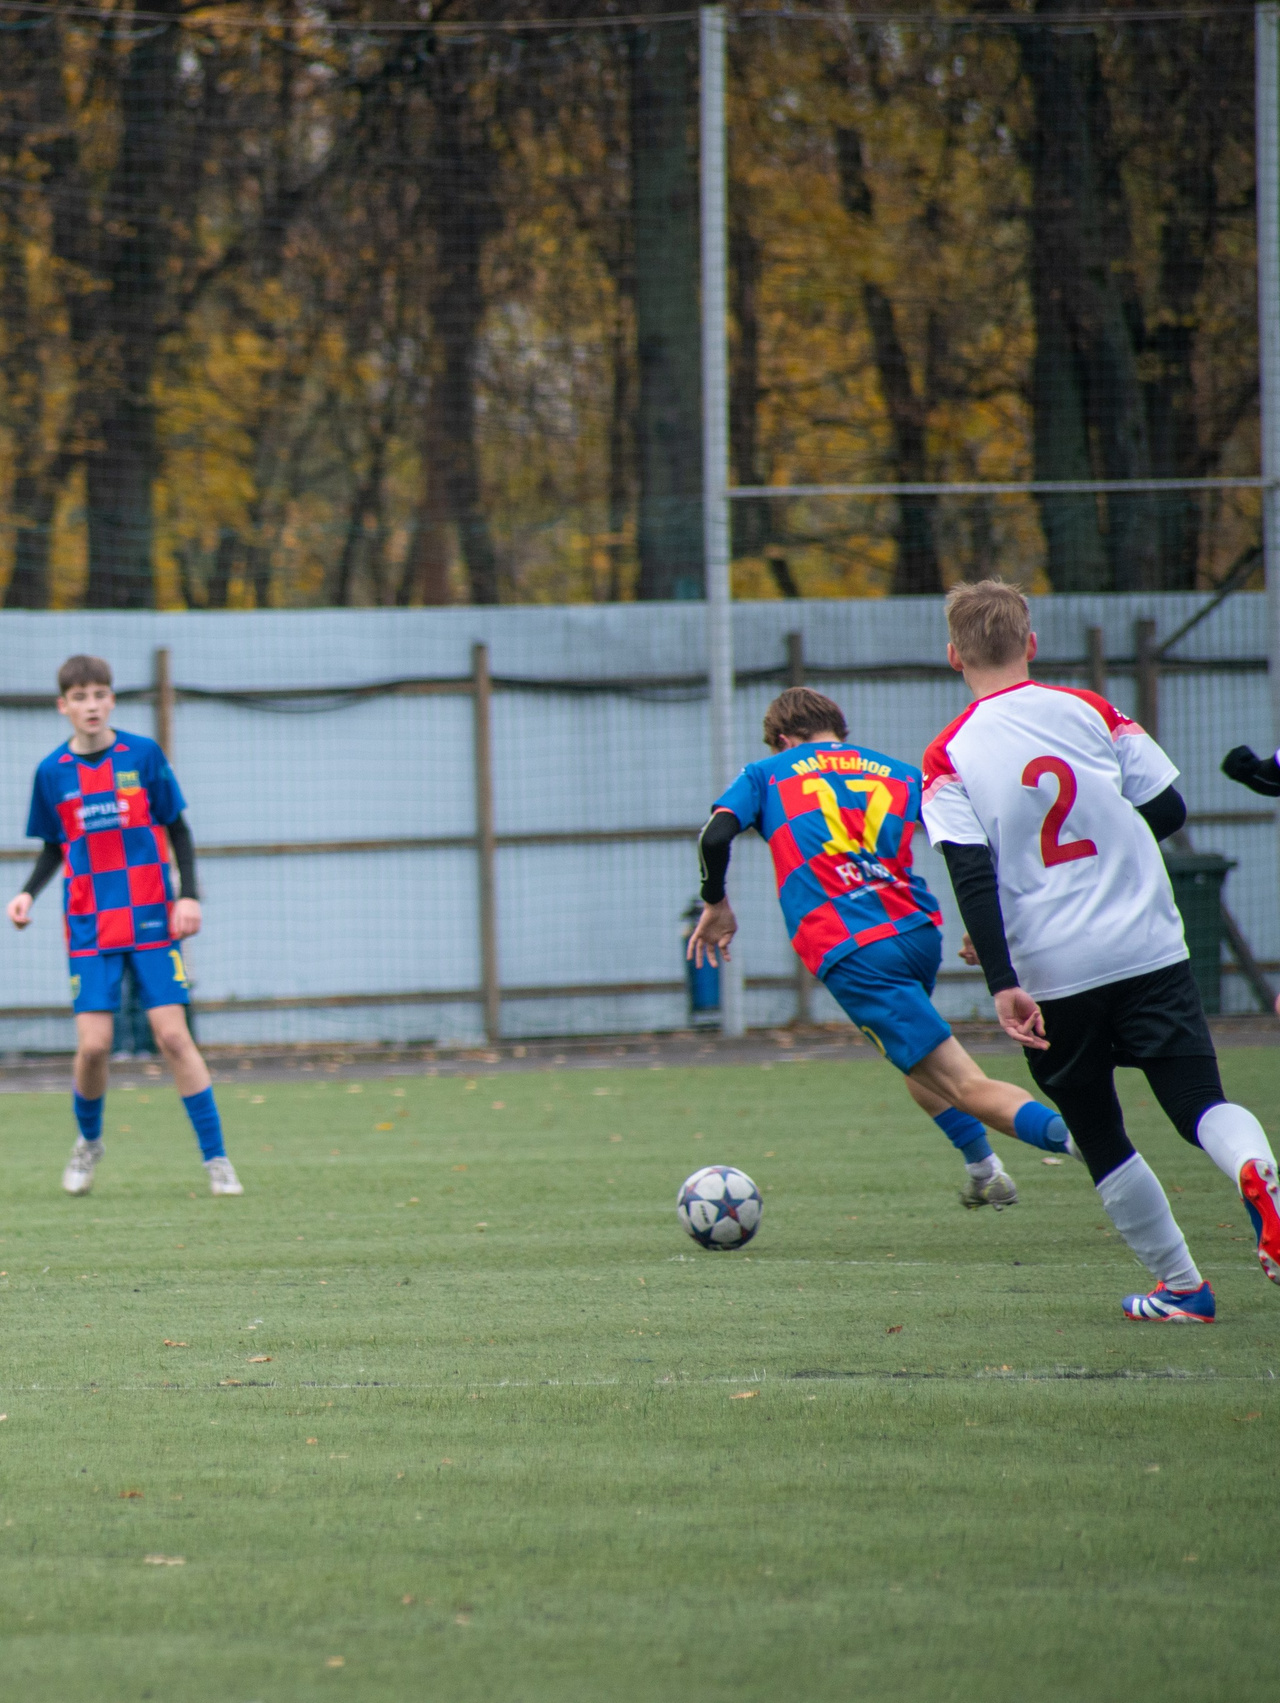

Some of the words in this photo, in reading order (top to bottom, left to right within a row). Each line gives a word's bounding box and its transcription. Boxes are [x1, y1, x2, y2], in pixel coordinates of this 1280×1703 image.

[802, 777, 893, 855] 17
[1021, 755, 1098, 868] 2
[835, 861, 863, 886] FC
